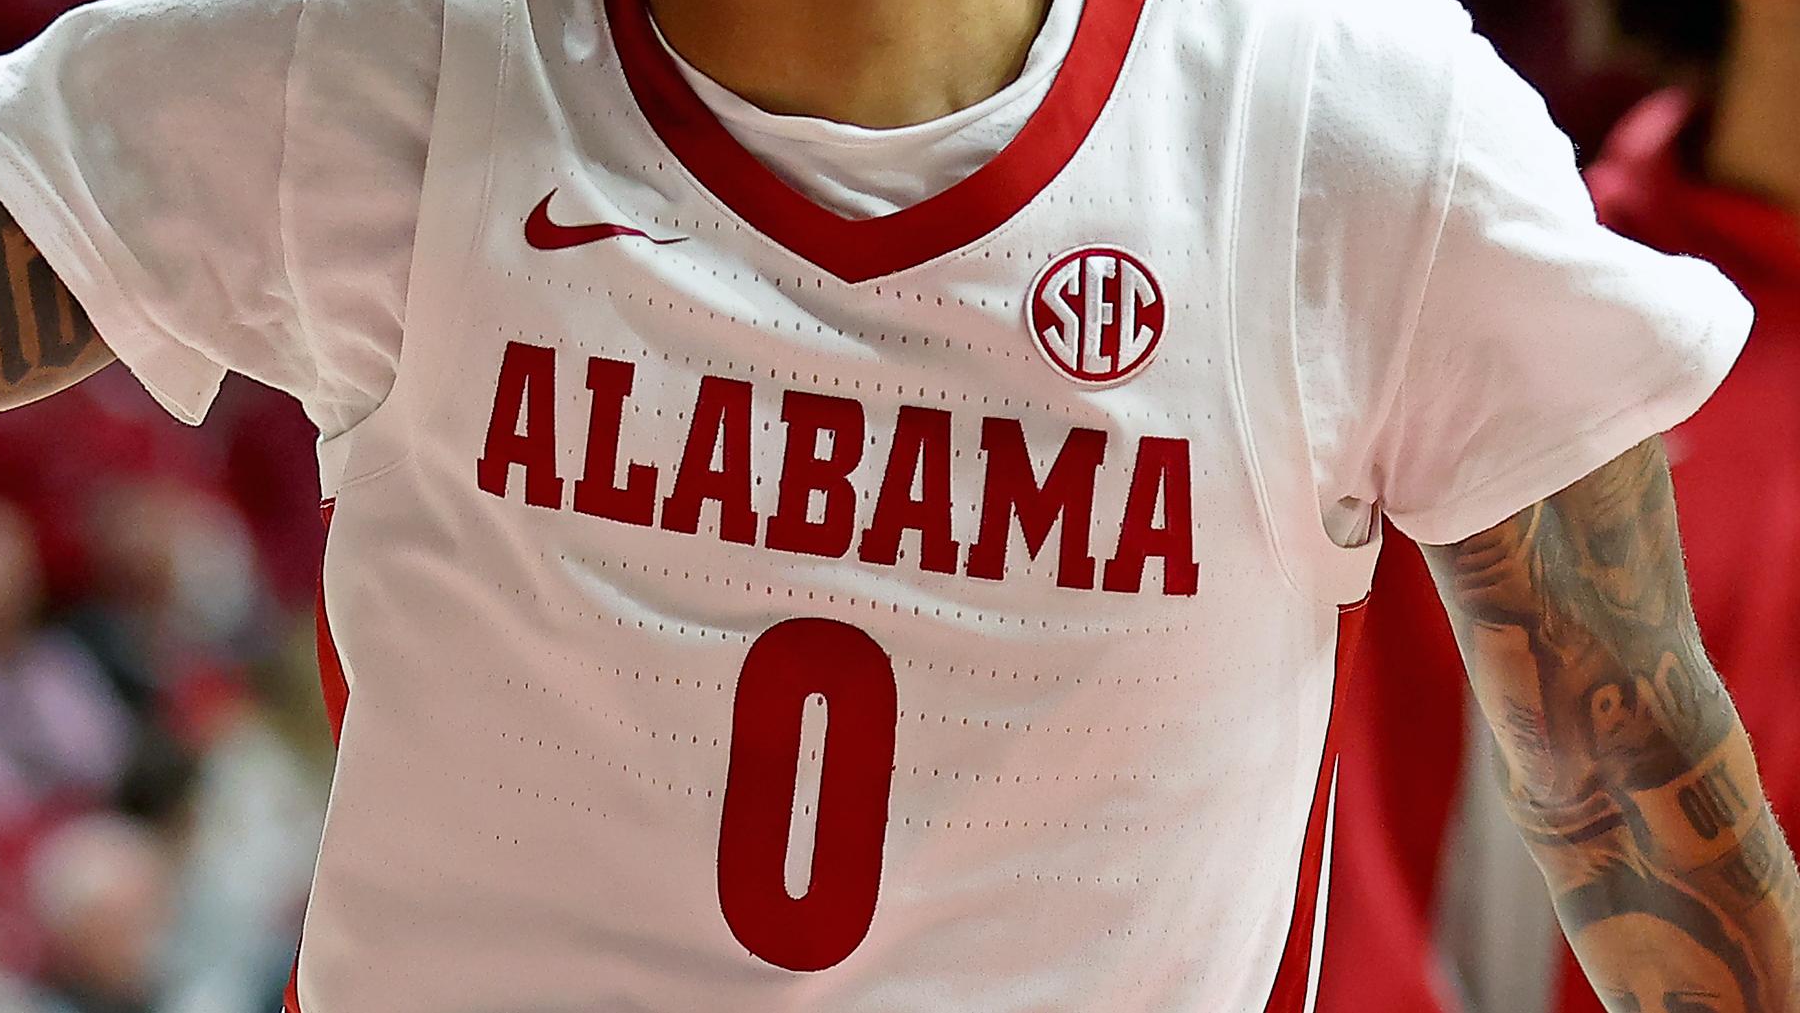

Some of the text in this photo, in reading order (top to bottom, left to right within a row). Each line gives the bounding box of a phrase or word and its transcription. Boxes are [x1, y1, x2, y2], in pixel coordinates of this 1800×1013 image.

[1041, 255, 1157, 374] SEC
[477, 340, 1200, 597] ALABAMA
[716, 617, 898, 973] 0
